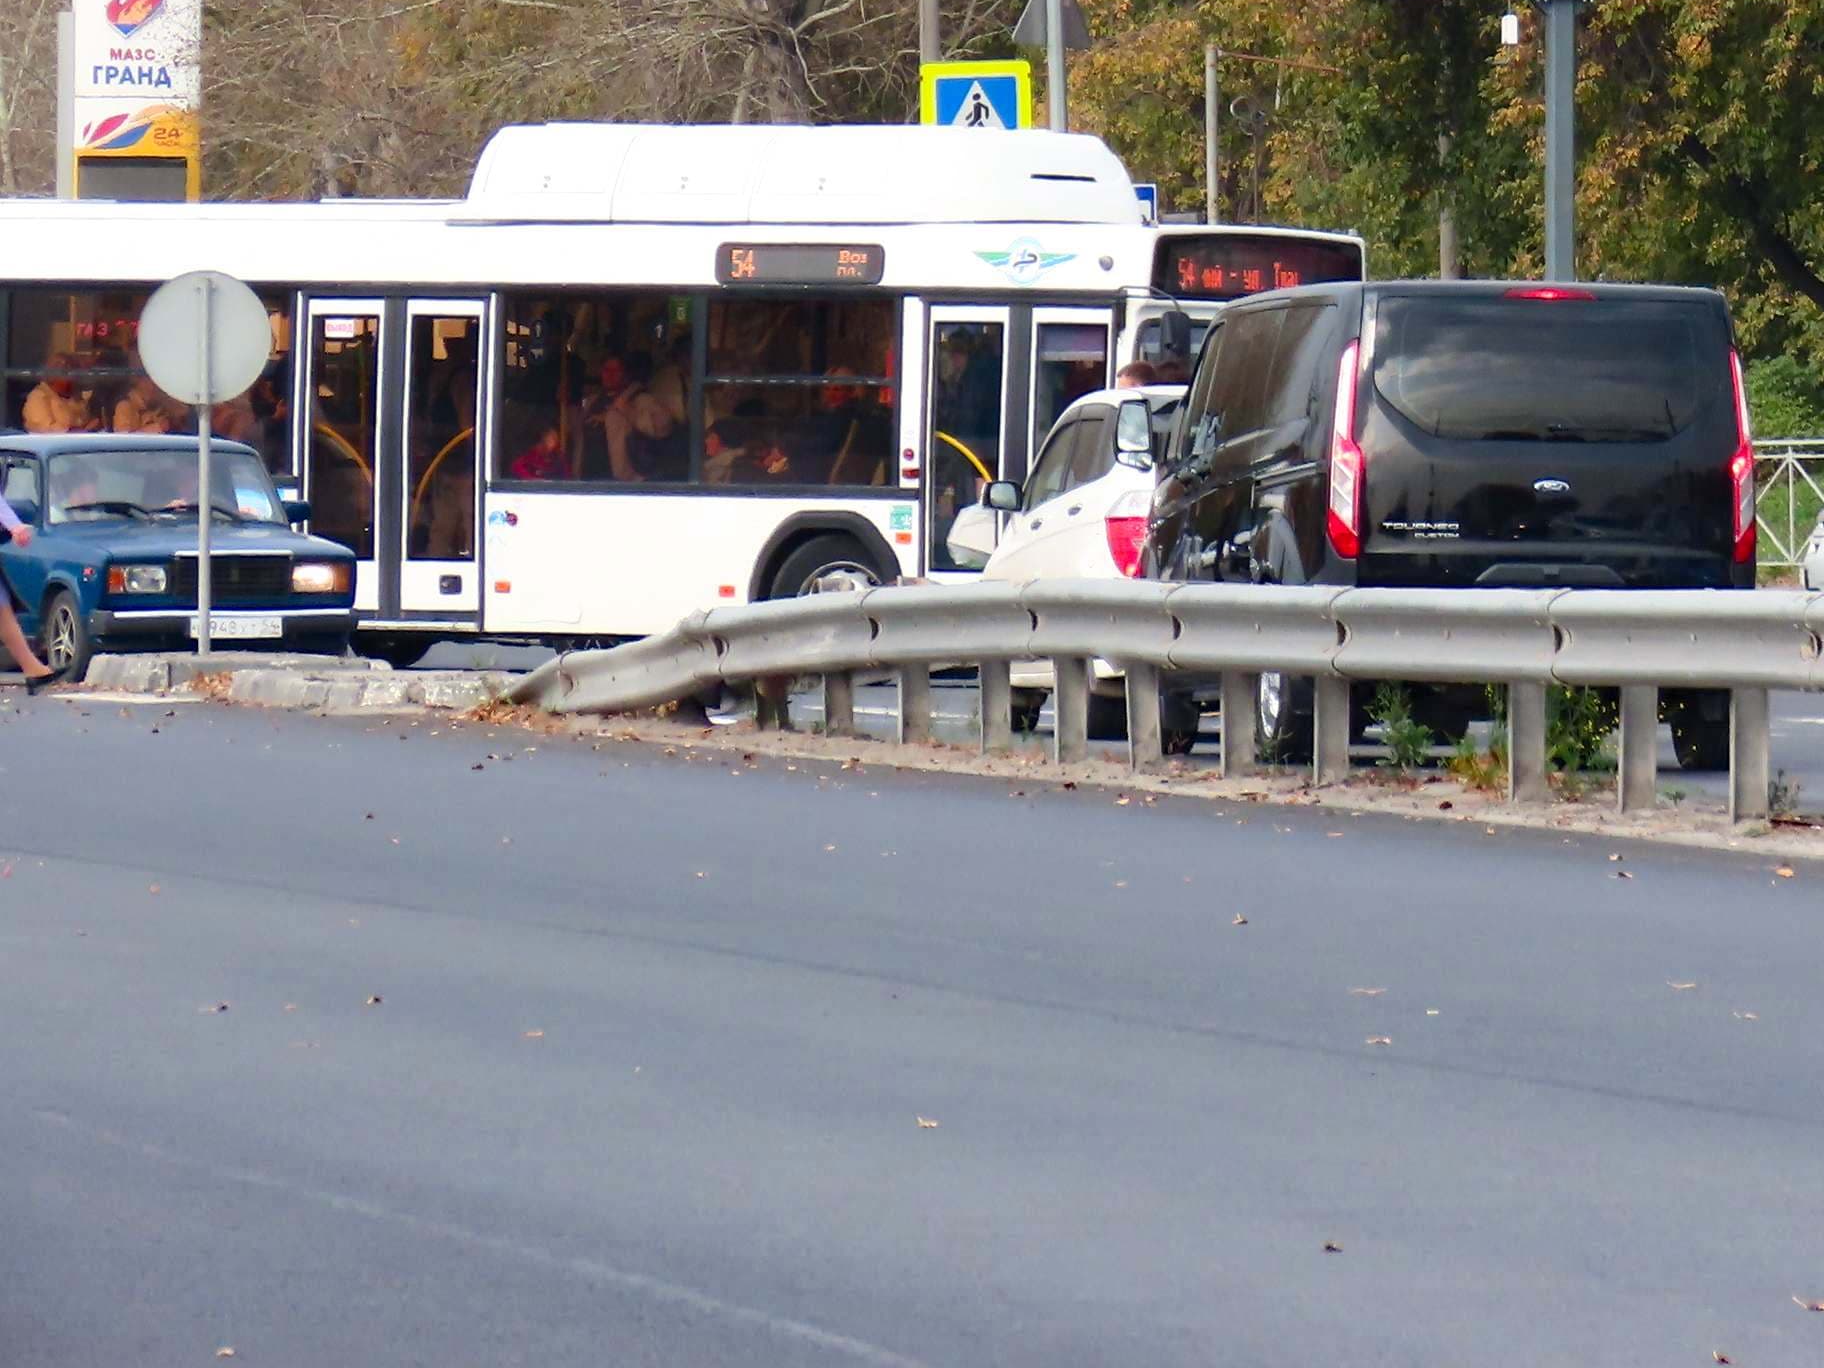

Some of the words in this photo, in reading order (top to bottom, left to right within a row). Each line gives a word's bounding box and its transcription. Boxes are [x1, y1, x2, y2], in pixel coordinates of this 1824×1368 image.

[110, 48, 156, 60] МАЗС
[93, 65, 171, 88] ГРАНД
[154, 128, 180, 140] 24
[731, 249, 756, 277] 54
